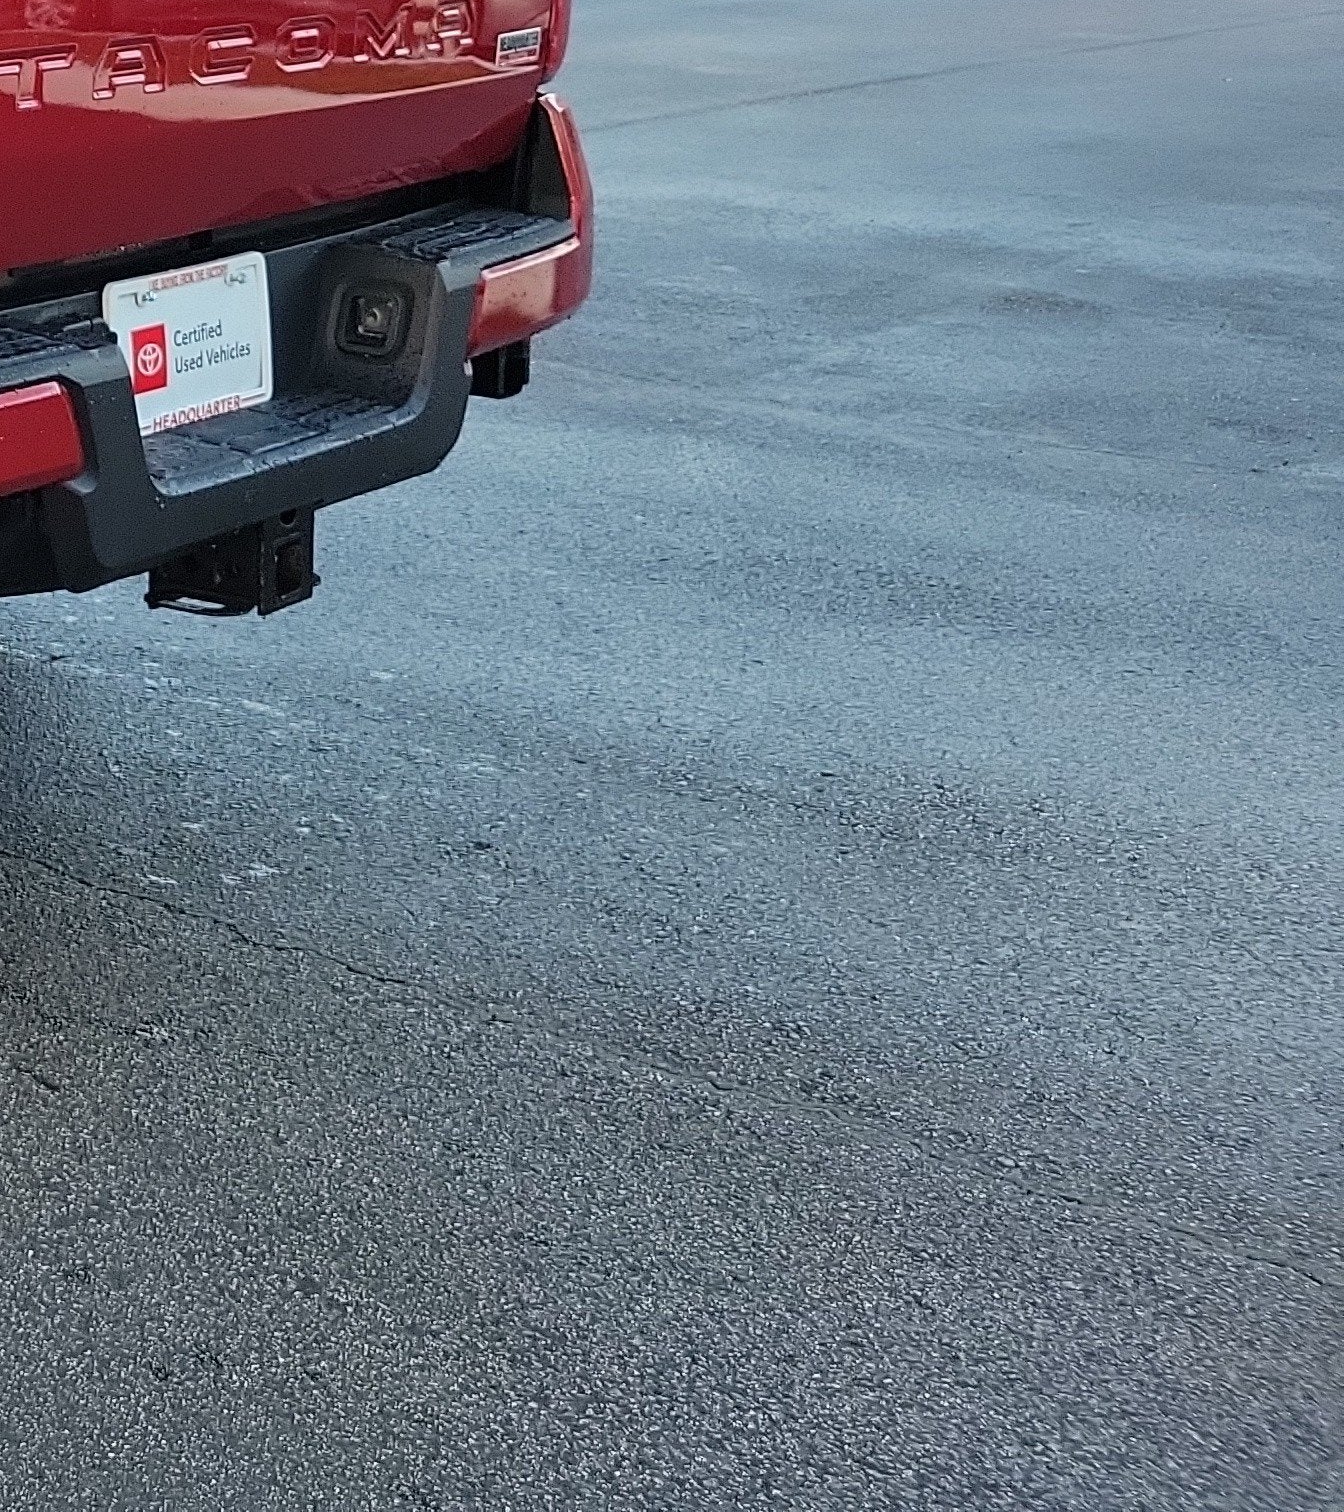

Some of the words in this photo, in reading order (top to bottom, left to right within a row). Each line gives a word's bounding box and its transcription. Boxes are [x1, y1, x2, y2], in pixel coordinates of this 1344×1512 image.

[173, 319, 223, 347] Certified
[174, 352, 203, 374] Used
[205, 341, 251, 365] Vehicles
[152, 394, 241, 432] HEADQUARTER
